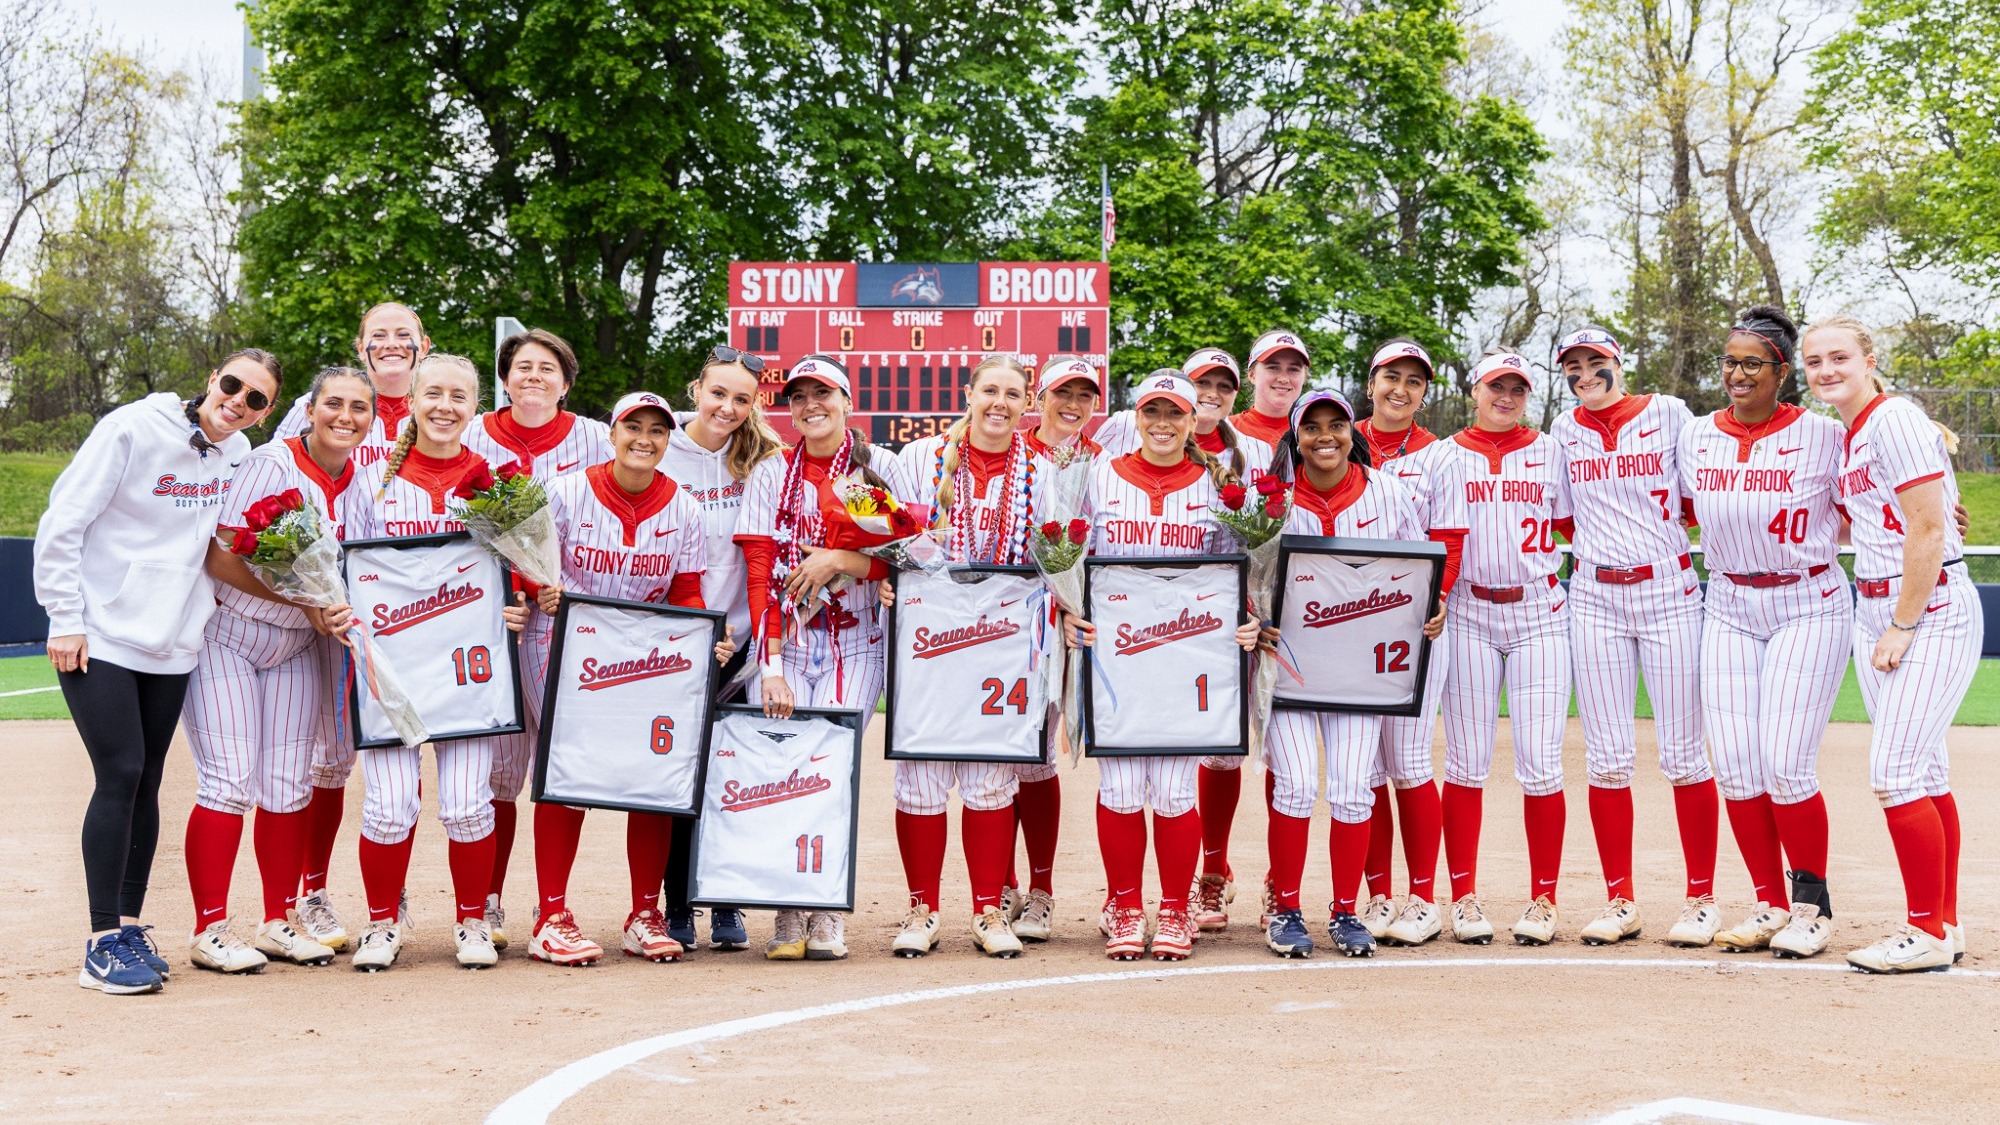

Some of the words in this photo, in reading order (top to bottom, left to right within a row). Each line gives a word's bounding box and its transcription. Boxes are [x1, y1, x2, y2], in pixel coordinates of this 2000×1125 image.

[741, 268, 844, 303] STONY
[989, 268, 1098, 303] BROOK
[738, 311, 757, 326] AT
[760, 311, 787, 326] BAT
[828, 311, 865, 326] BALL
[892, 311, 943, 326] STRIKE
[973, 311, 1004, 326] OUT
[1061, 311, 1086, 328] H/E
[840, 326, 854, 351] 0
[911, 326, 925, 351] 0
[982, 326, 996, 351] 0
[862, 354, 870, 366] 4
[881, 354, 889, 366] 5
[899, 354, 908, 366] 6
[924, 354, 931, 366] 7
[941, 354, 949, 366] 8
[960, 354, 968, 366] 9
[1570, 457, 1611, 483] STONY
[1616, 452, 1664, 478] BROOK
[1696, 468, 1740, 491] STONY
[1743, 469, 1795, 493] BROOK
[1502, 480, 1545, 507] BROOK
[1650, 489, 1670, 521] 7
[1106, 520, 1156, 545] STONY
[1160, 522, 1207, 550] BROOK
[1521, 517, 1556, 553] 20
[1768, 508, 1809, 544] 40
[1882, 503, 1905, 536] 4
[574, 545, 627, 576] STONY
[629, 553, 674, 577] BROOK
[358, 574, 379, 582] CAA
[371, 582, 484, 630] Seawolves
[1303, 588, 1413, 623] Seawolves
[576, 626, 596, 634] CAA
[913, 615, 1021, 652] Seawolves
[1115, 608, 1223, 649] Seawolves
[451, 645, 493, 686] 18
[579, 647, 692, 683] Seawolves
[1373, 640, 1410, 674] 12
[981, 678, 1029, 715] 24
[1195, 673, 1208, 712] 1
[650, 715, 674, 755] 6
[721, 768, 831, 805] Seawolves
[795, 834, 823, 873] 11
